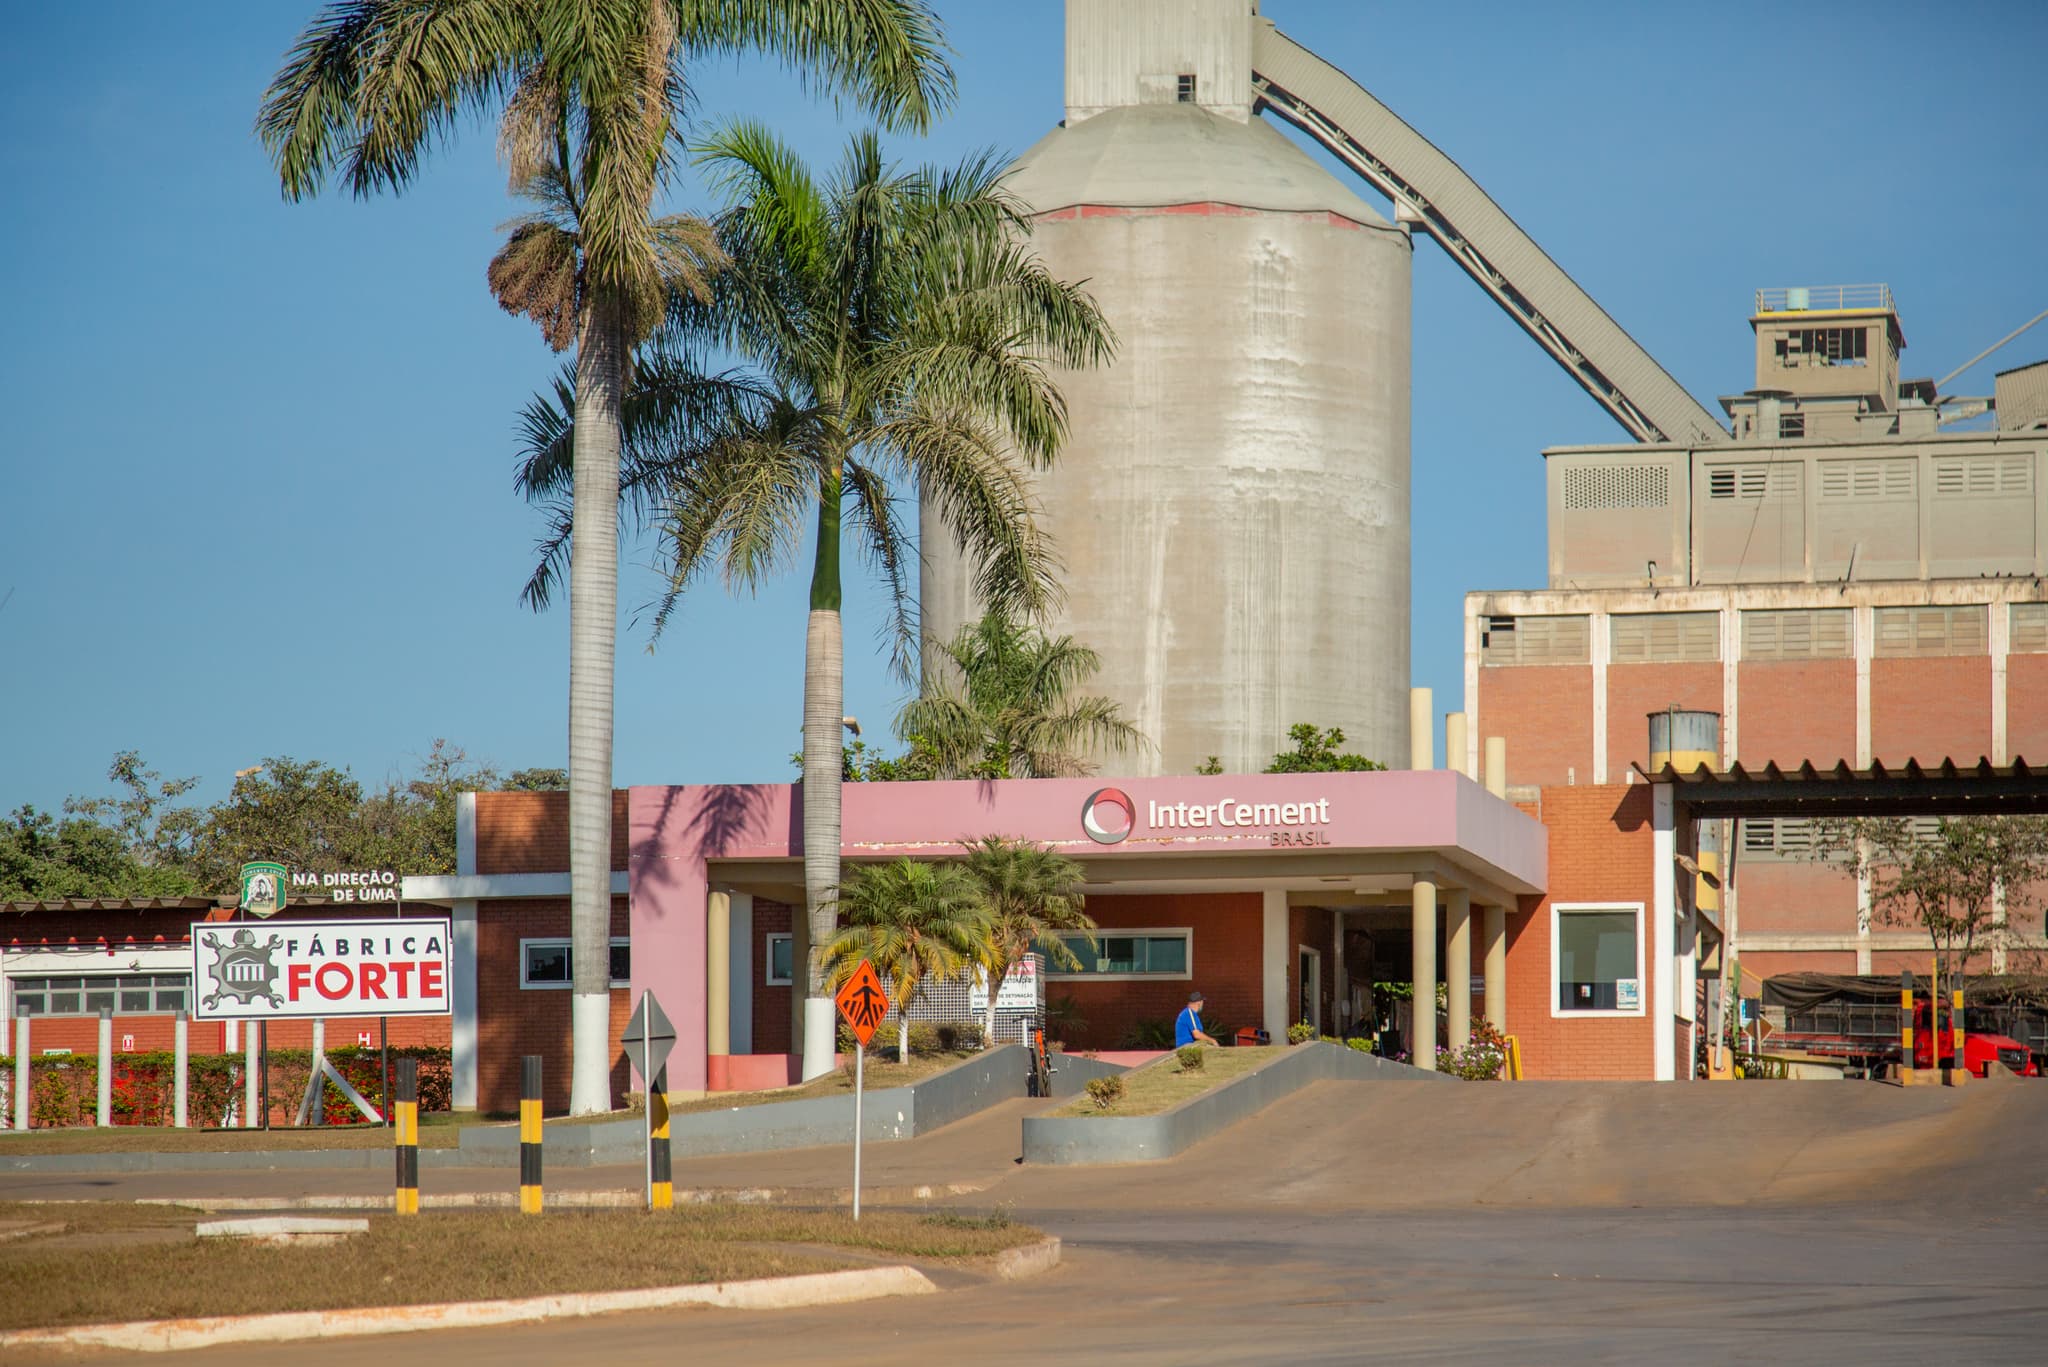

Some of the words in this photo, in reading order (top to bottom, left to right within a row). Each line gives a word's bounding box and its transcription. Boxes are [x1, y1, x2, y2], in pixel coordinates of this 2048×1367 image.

[1149, 798, 1330, 828] InterCement
[1270, 832, 1331, 846] BRASIL
[293, 873, 319, 886] NA
[323, 870, 395, 889] DIREÇÃO
[333, 889, 354, 902] DE
[359, 888, 397, 901] UMA
[287, 933, 442, 957] FÁBRICA
[288, 961, 443, 1002] FORTE
